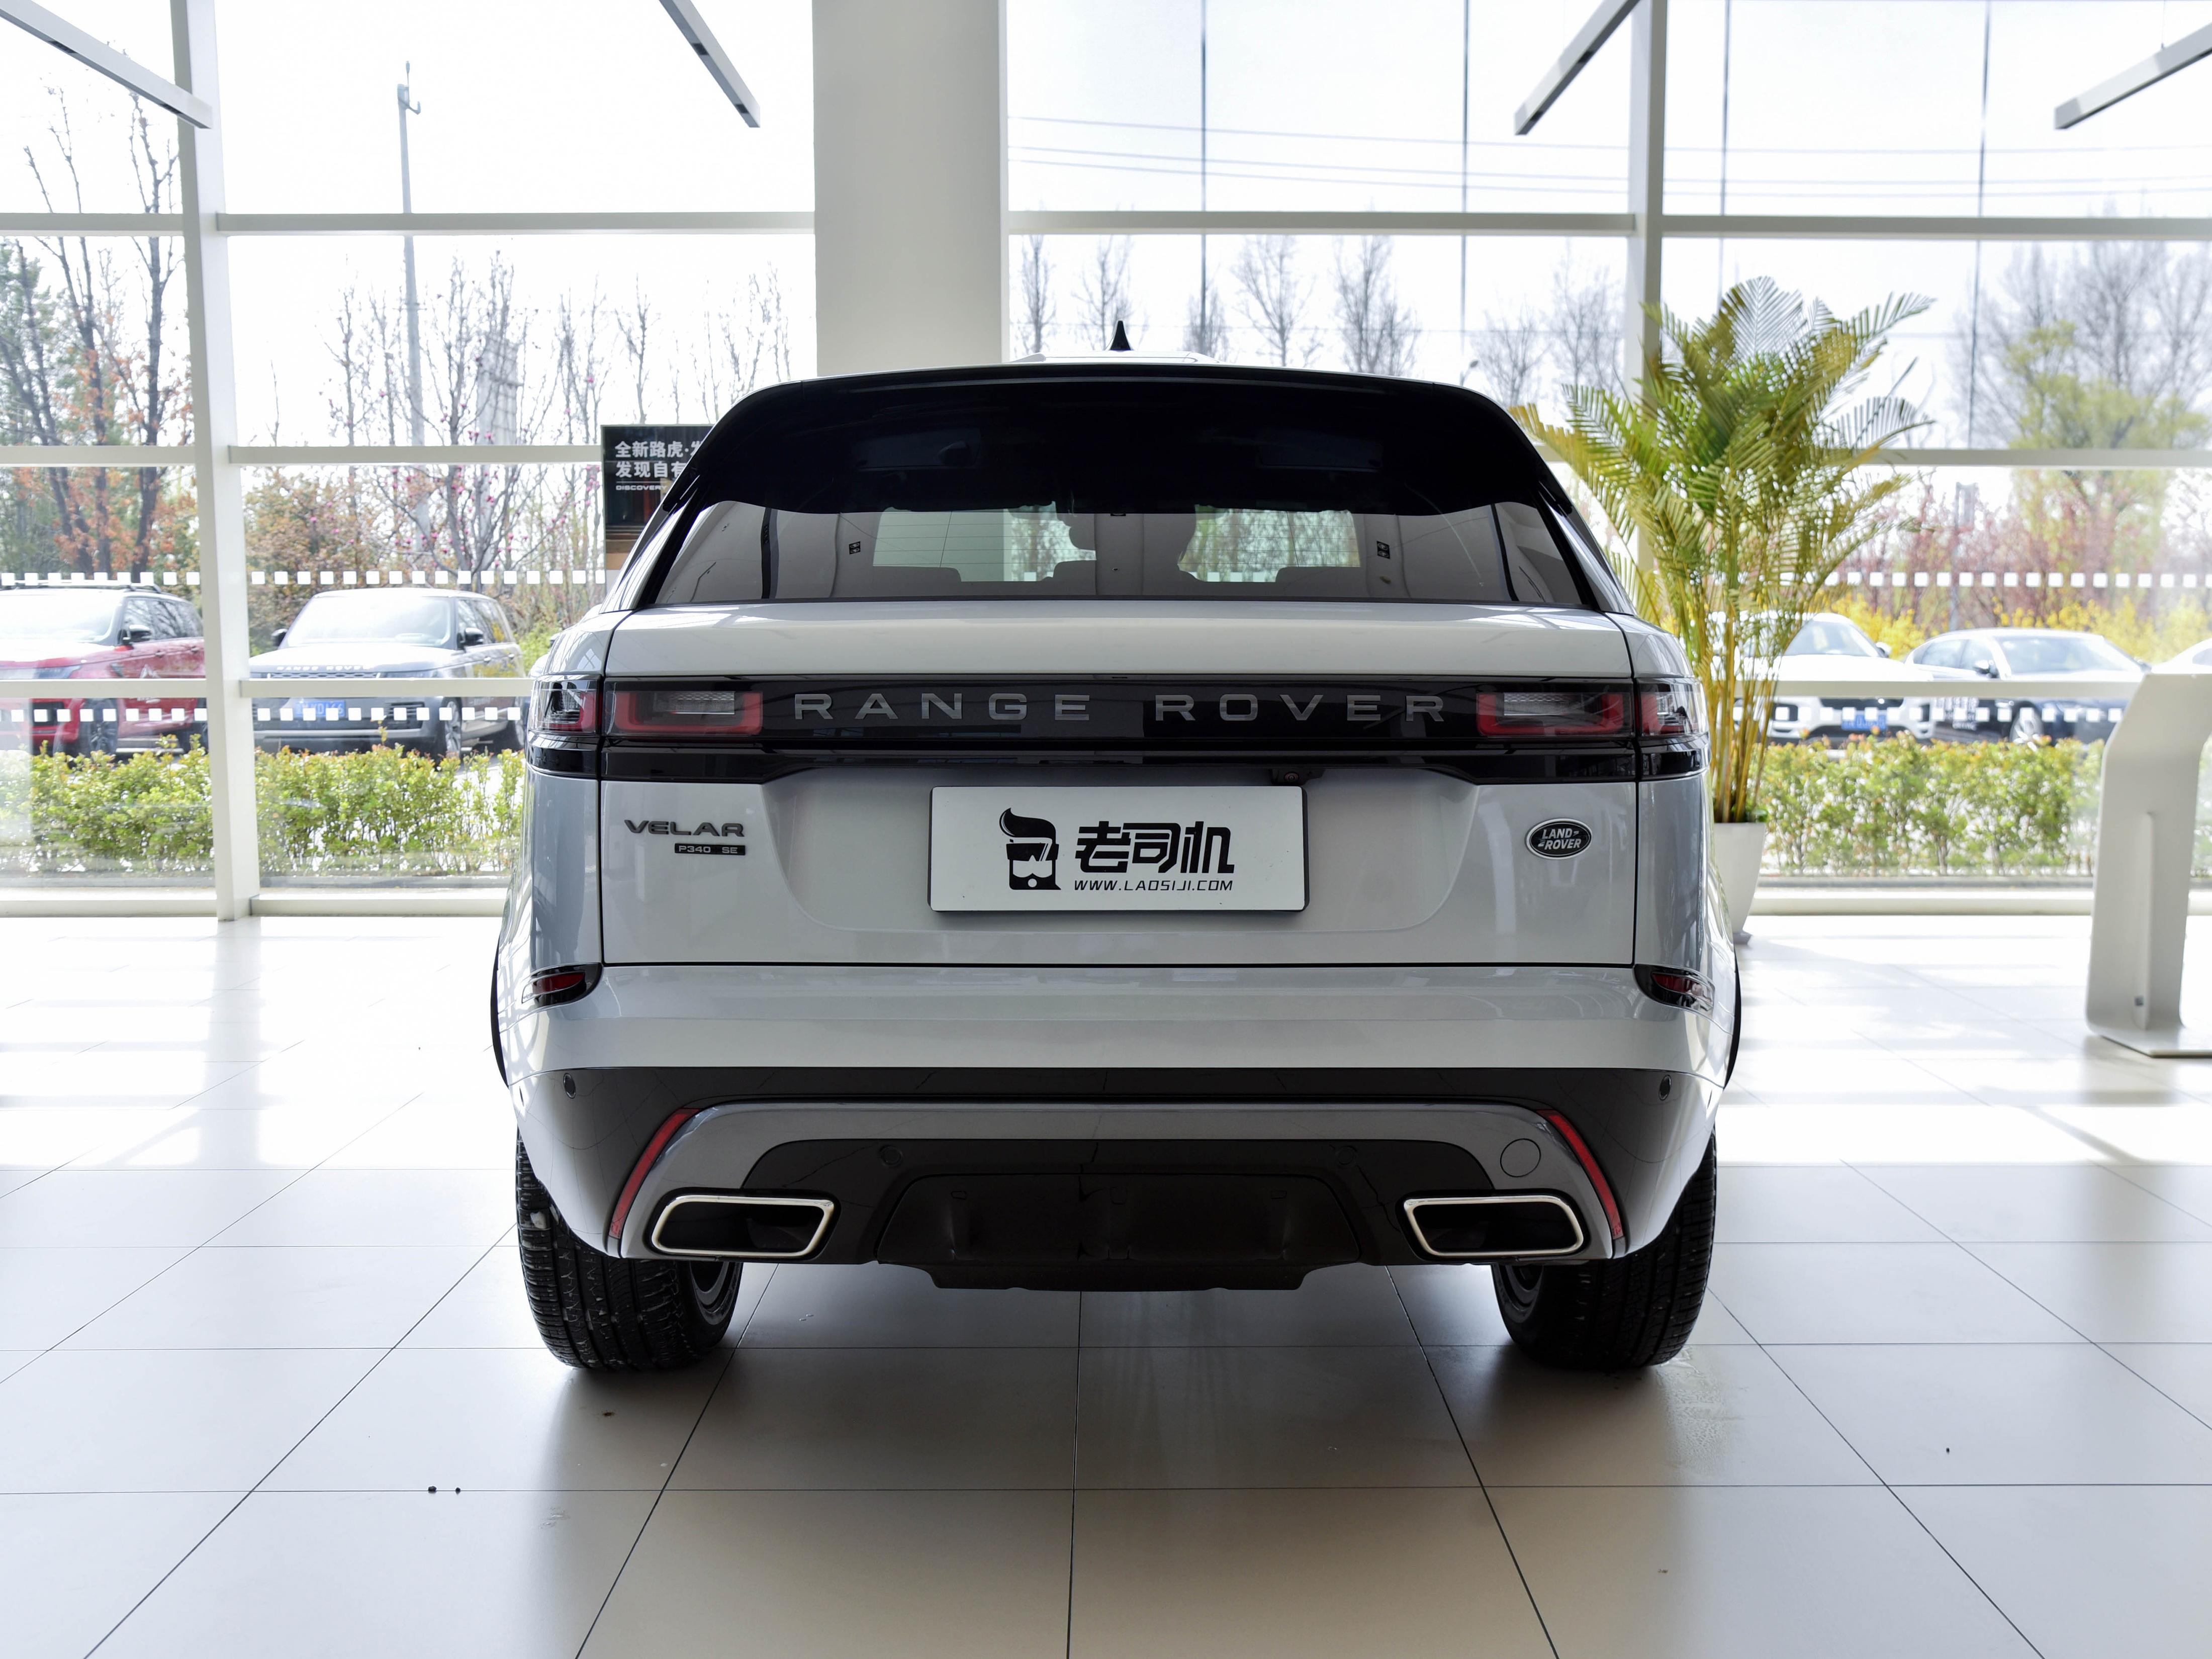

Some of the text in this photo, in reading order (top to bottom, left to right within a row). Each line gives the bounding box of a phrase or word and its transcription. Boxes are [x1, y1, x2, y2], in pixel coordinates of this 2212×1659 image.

[794, 693, 1444, 722] RANGE ROVER
[624, 819, 745, 837] VELAR
[1542, 828, 1573, 839] LAND
[1075, 821, 1235, 874] 老司机
[1544, 838, 1582, 850] ROVER
[1074, 880, 1233, 891] WWW.LAOSIJI.COM
